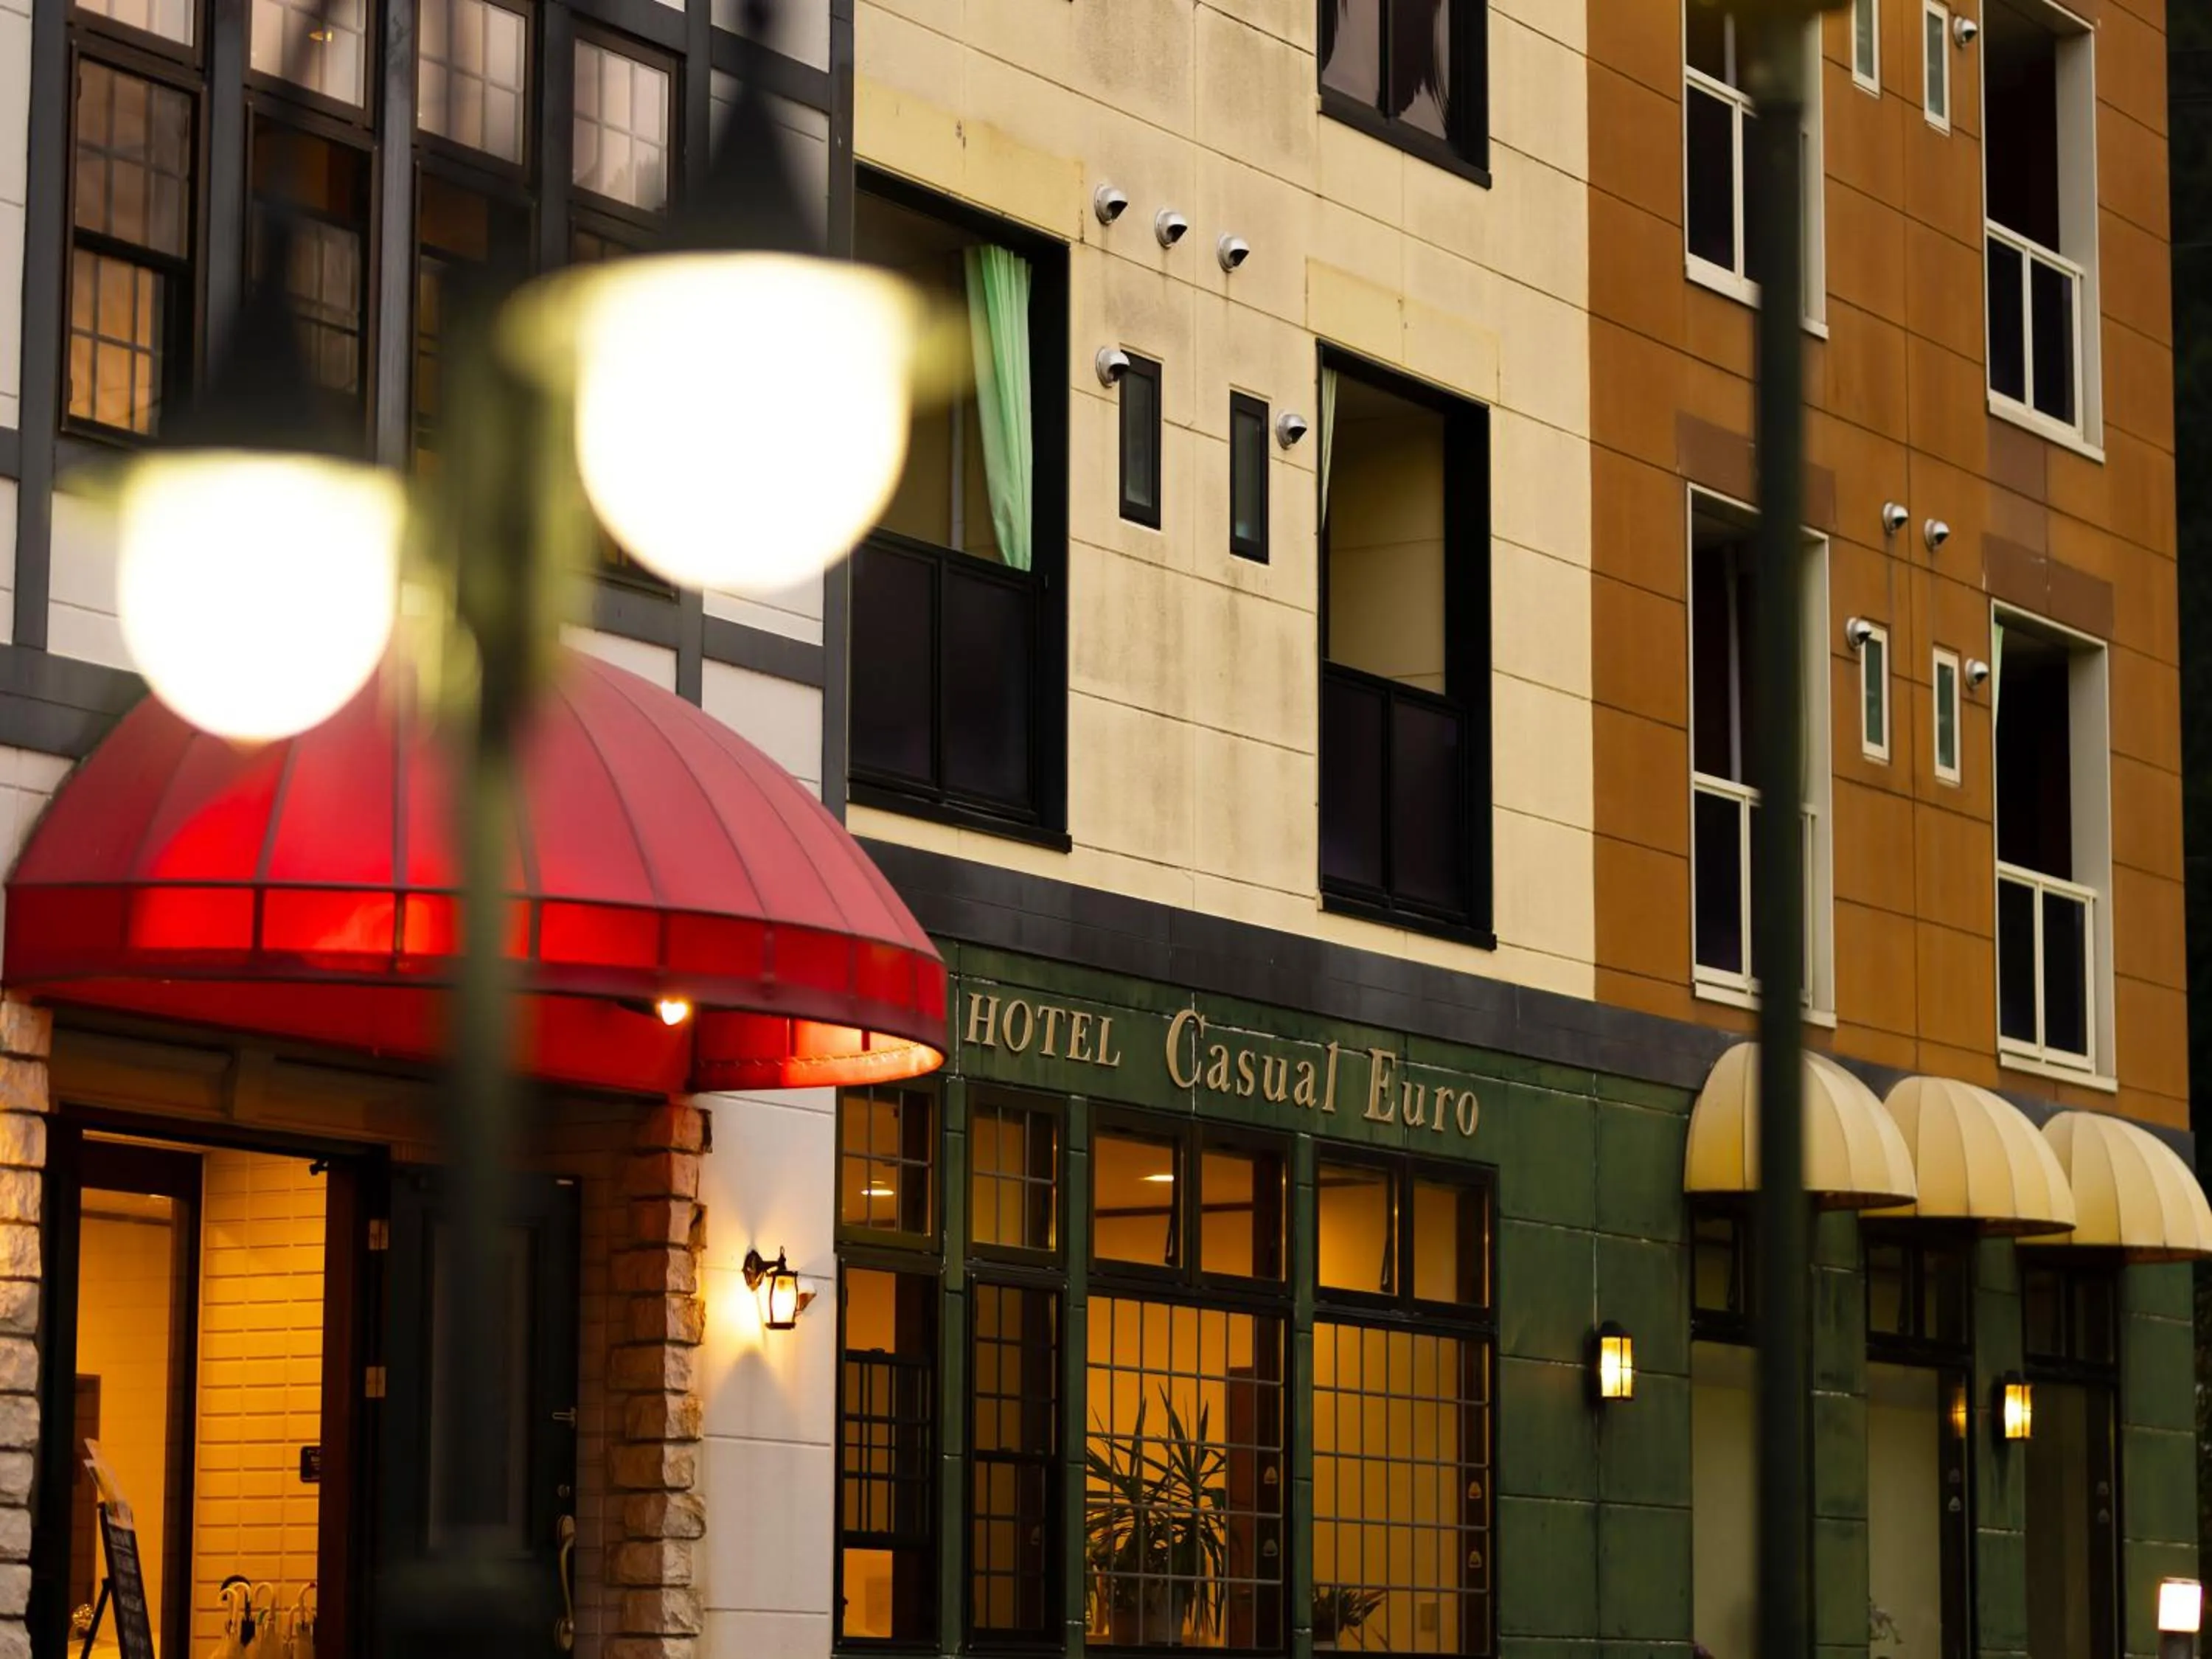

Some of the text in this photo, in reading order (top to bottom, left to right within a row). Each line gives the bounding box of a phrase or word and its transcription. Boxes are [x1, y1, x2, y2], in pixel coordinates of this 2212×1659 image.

[964, 992, 1480, 1137] HOTEL Casual Euro
